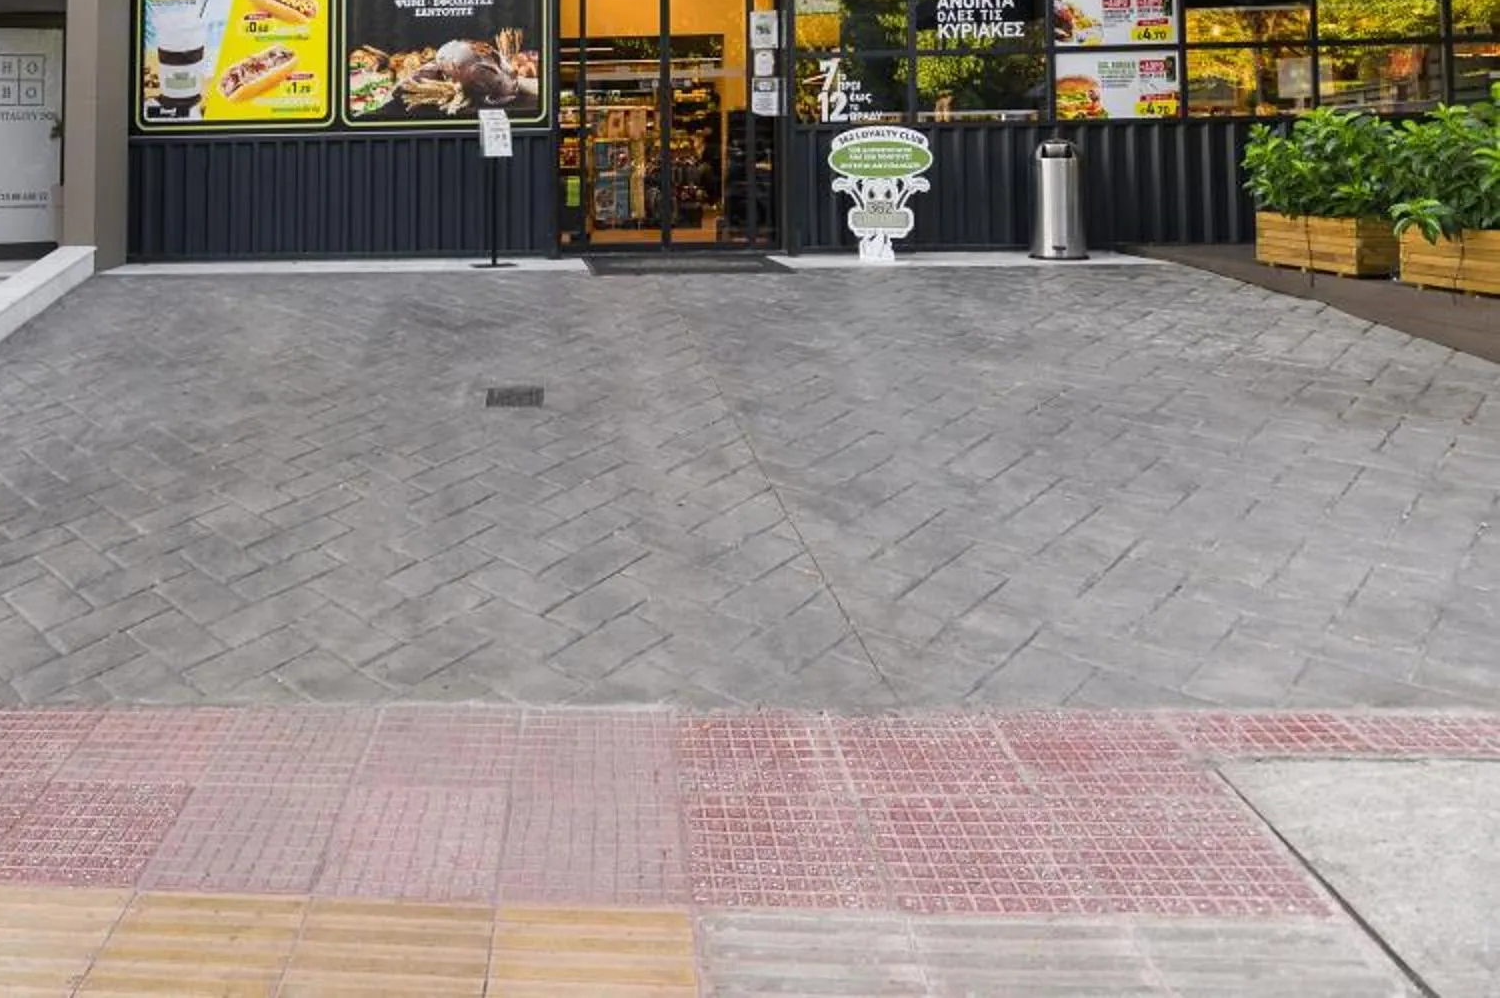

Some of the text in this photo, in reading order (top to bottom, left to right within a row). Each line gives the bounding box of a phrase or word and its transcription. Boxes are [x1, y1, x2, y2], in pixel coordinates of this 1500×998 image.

[937, 9, 1003, 22] ΟΛΕΣ ΤΙΣ
[937, 21, 1025, 39] ΚΥΡΙΑΚΕΣ
[818, 91, 848, 123] 12
